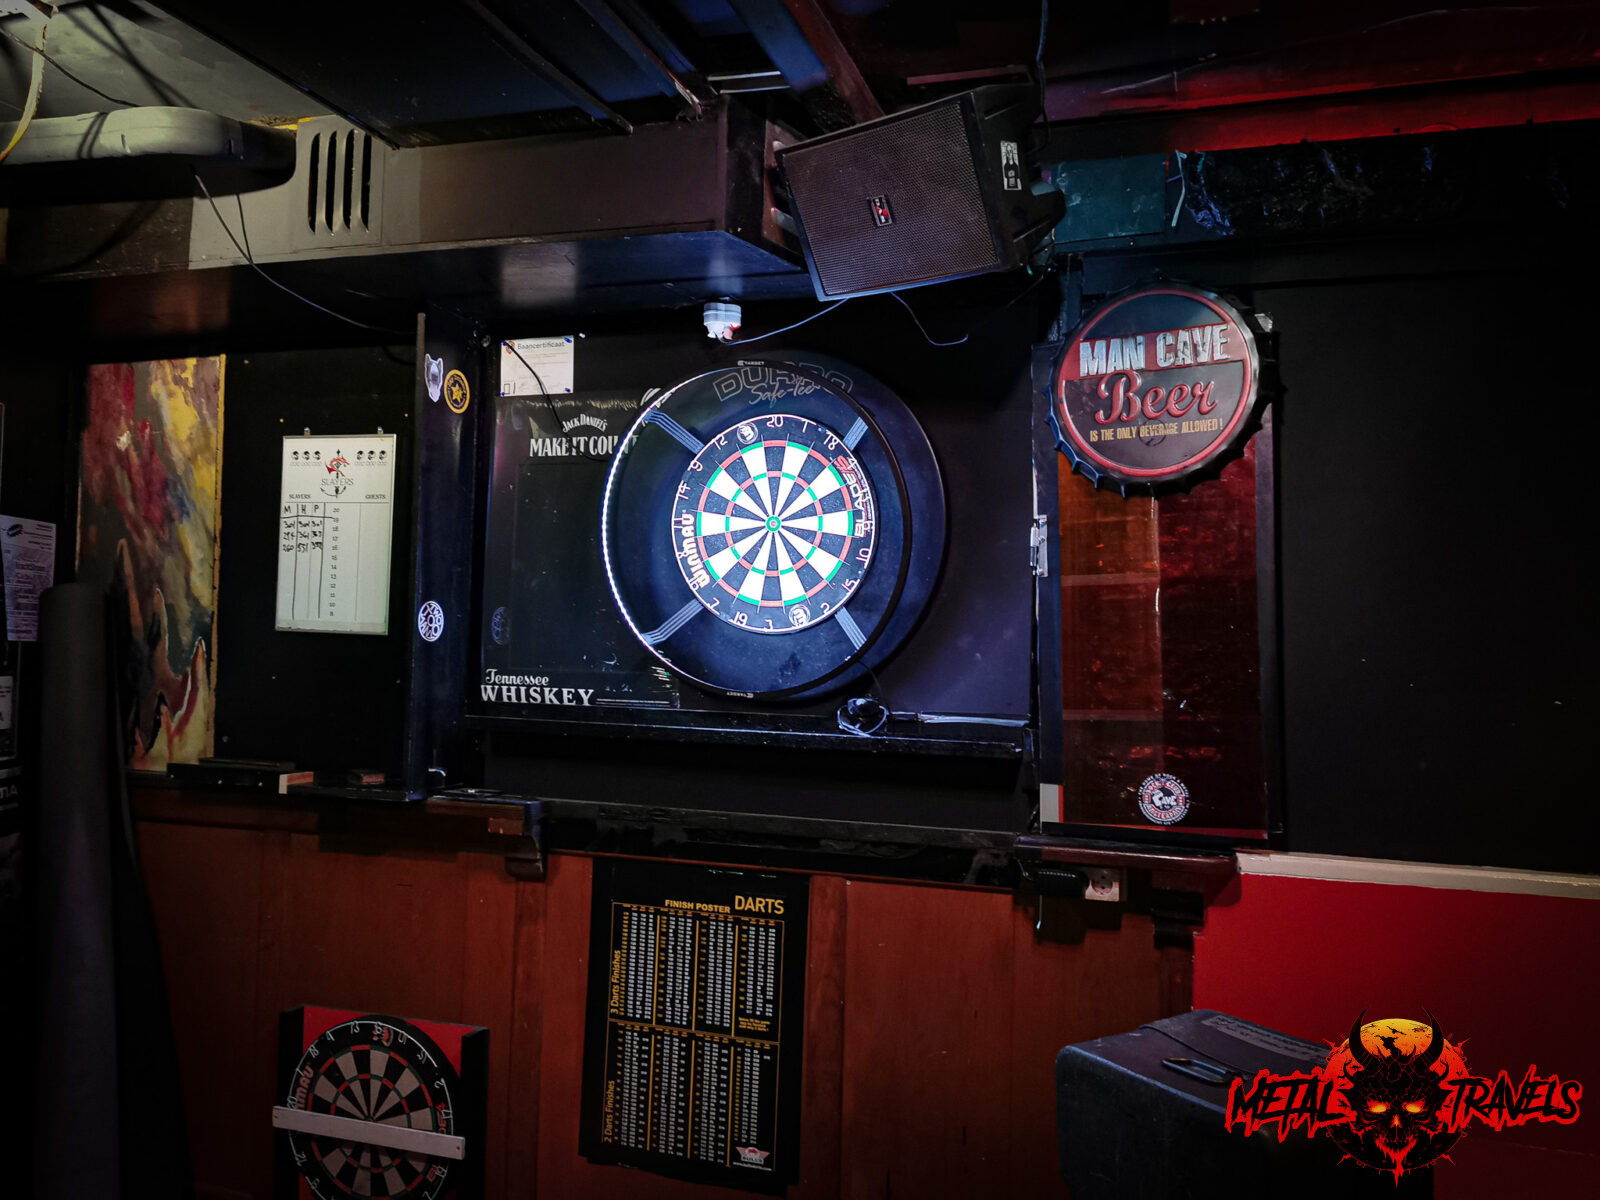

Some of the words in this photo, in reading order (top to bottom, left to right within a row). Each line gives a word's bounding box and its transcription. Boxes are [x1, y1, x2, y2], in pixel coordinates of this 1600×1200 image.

[1080, 335, 1146, 377] MAN
[1156, 323, 1231, 368] CAVE
[1094, 370, 1218, 425] Beer
[562, 416, 580, 433] JACK
[766, 416, 784, 428] 20
[1090, 430, 1099, 442] IS
[1101, 428, 1114, 441] THE
[1116, 426, 1137, 439] ONLY
[1139, 422, 1178, 437] BEVERAGE
[1181, 419, 1218, 434] ALLOWED
[529, 437, 570, 457] MAKE
[711, 434, 728, 450] 12
[823, 430, 840, 450] 18
[691, 460, 703, 472] 9
[734, 611, 749, 626] 19
[485, 668, 549, 686] Tennessee
[480, 684, 595, 706] WHISKEY
[664, 899, 694, 910] FINISH
[696, 902, 731, 914] POSTER
[734, 895, 785, 915] DARTS
[611, 949, 621, 984] Finishes
[610, 984, 620, 1008] Darts
[604, 1080, 616, 1113] Finishes
[604, 1114, 614, 1136] Darts
